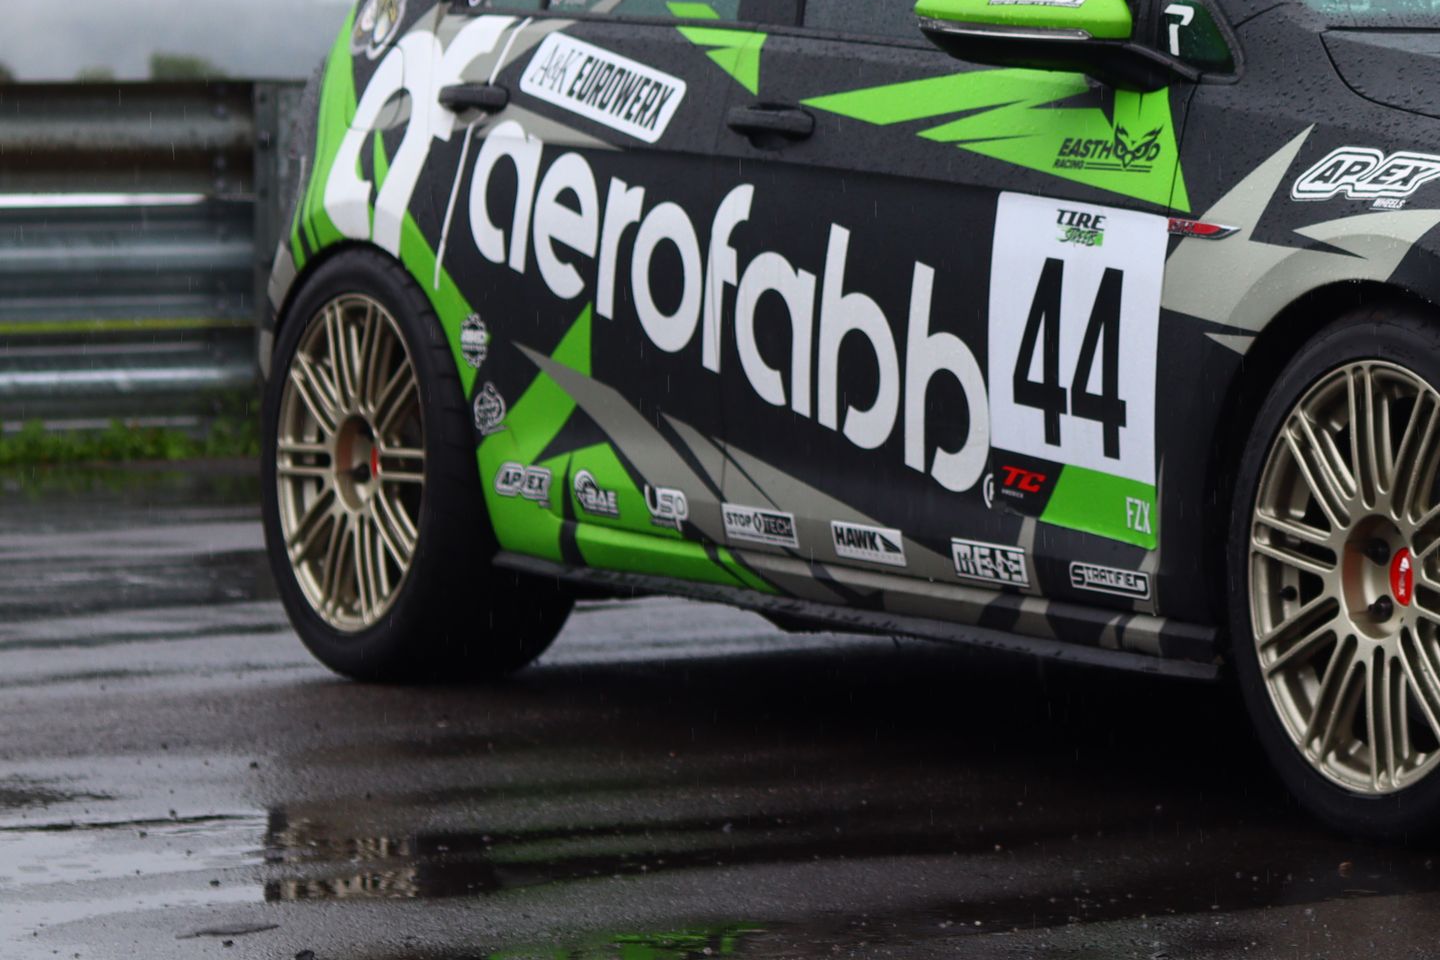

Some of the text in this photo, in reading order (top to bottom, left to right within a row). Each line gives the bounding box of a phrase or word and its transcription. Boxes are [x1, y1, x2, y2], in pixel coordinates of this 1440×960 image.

[566, 55, 675, 131] EUROWERX
[1056, 208, 1107, 231] TIRE
[469, 120, 989, 492] aerofabb
[1013, 257, 1126, 460] 44
[1002, 465, 1047, 493] TC
[1126, 496, 1151, 535] FZX
[834, 525, 879, 552] HAWK
[1071, 564, 1148, 597] STRATIFIED
